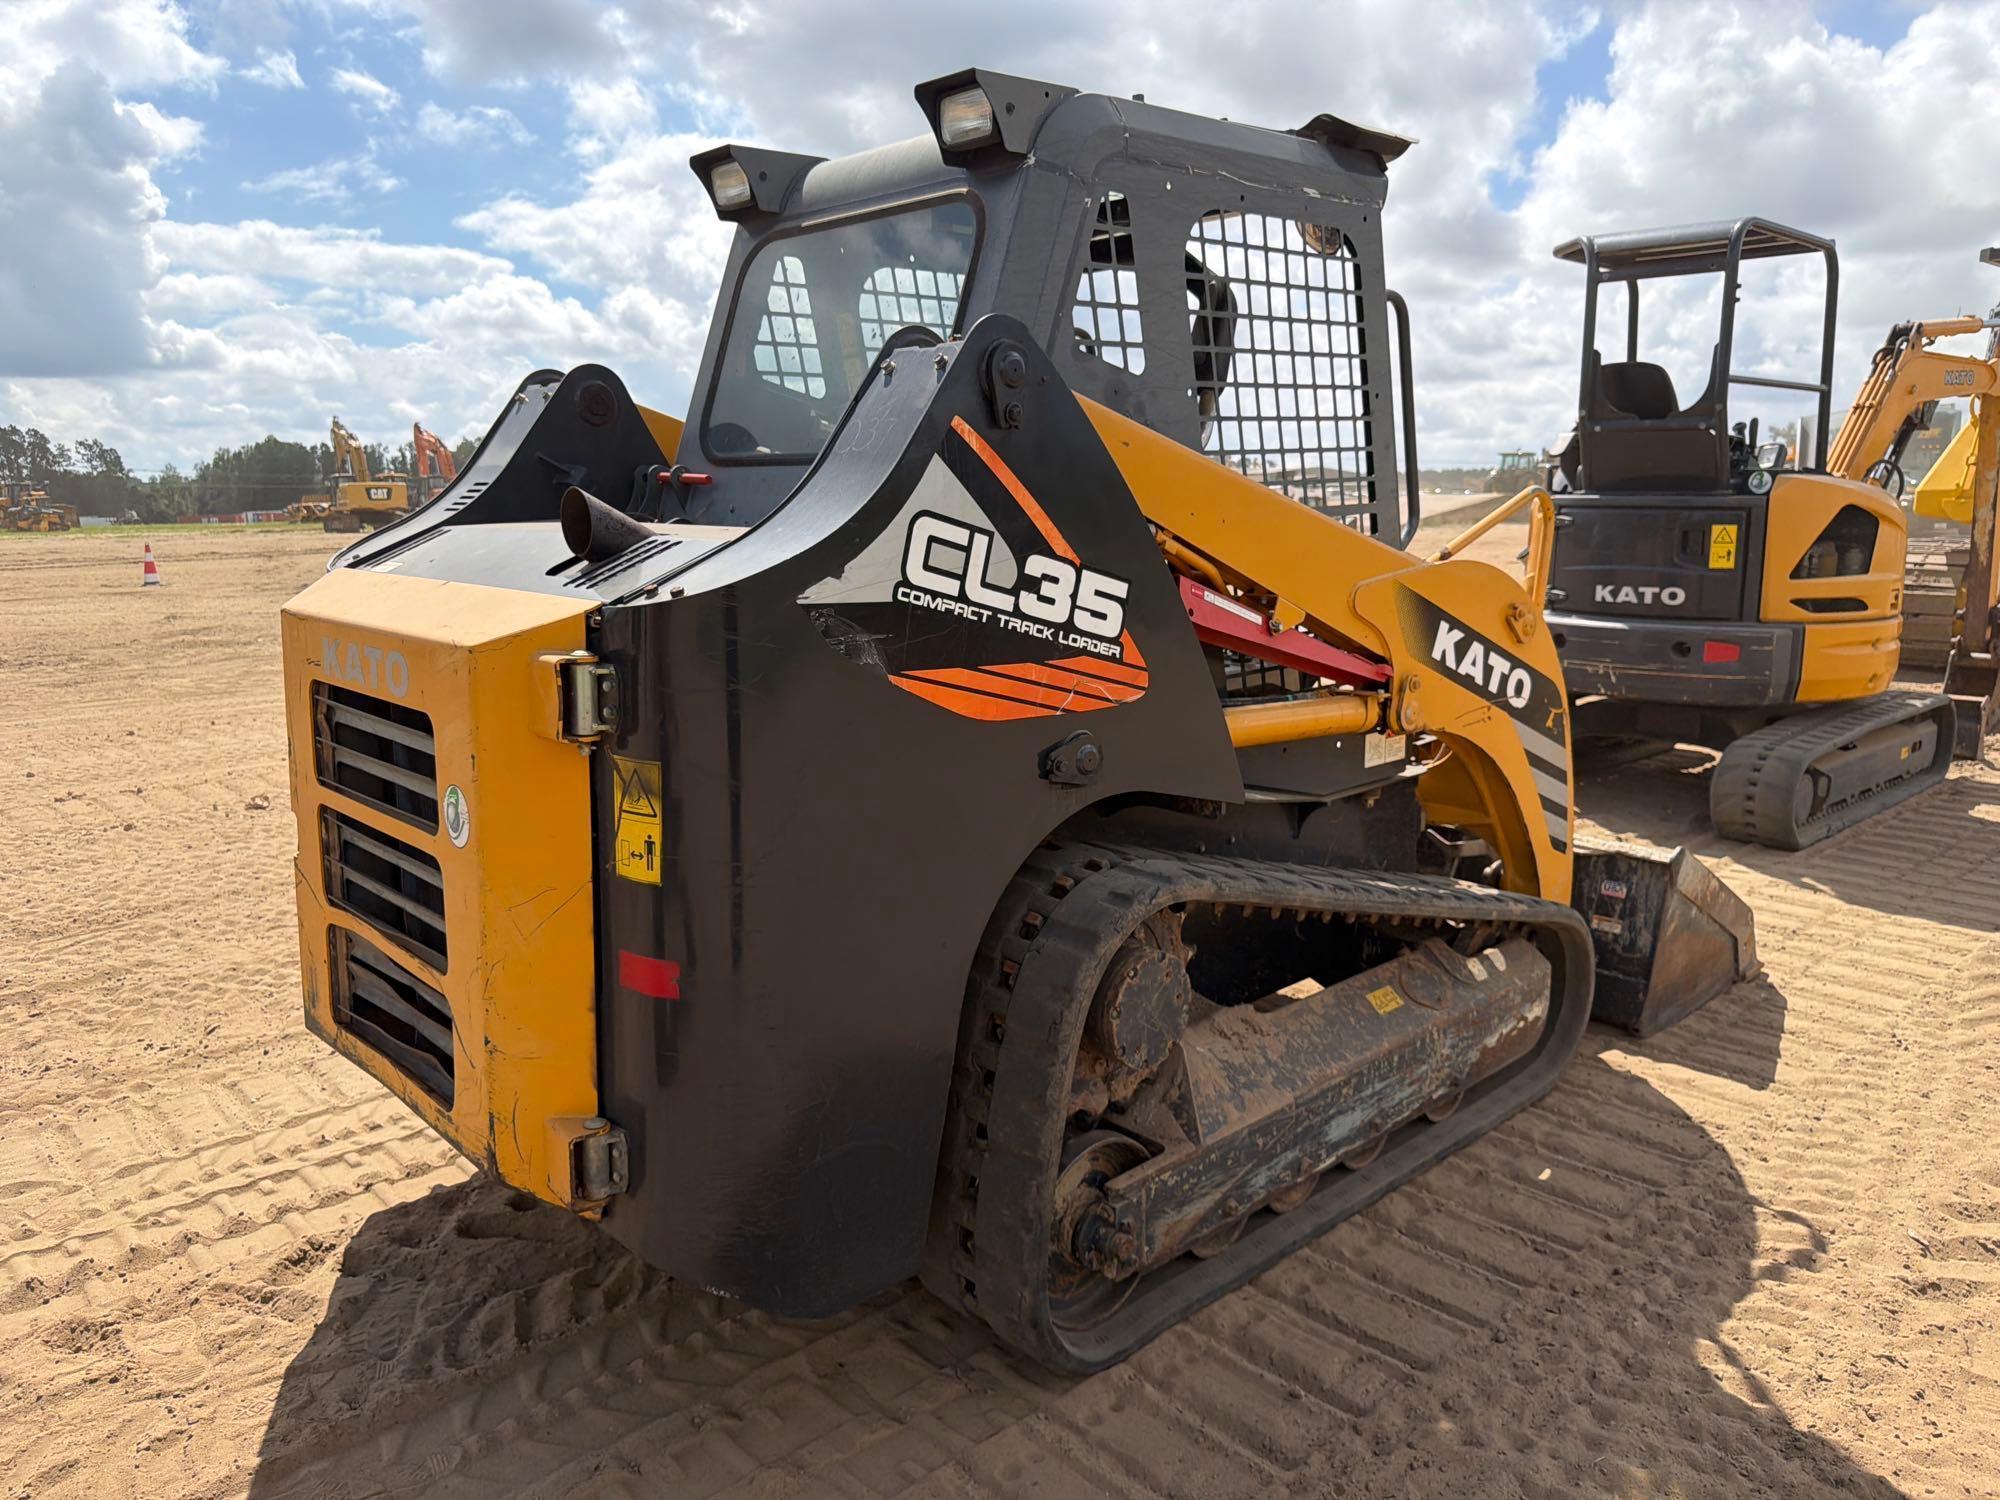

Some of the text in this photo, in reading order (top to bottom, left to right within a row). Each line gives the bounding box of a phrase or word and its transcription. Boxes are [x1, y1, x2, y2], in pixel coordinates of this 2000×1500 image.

[1944, 369, 1975, 386] KATO
[370, 488, 388, 500] CAT
[906, 515, 1129, 638] CL35
[1594, 584, 1686, 606] KATO
[896, 588, 1121, 659] COMPACT TRACK LOADER
[322, 640, 409, 698] KATO
[1431, 620, 1532, 709] KATO
